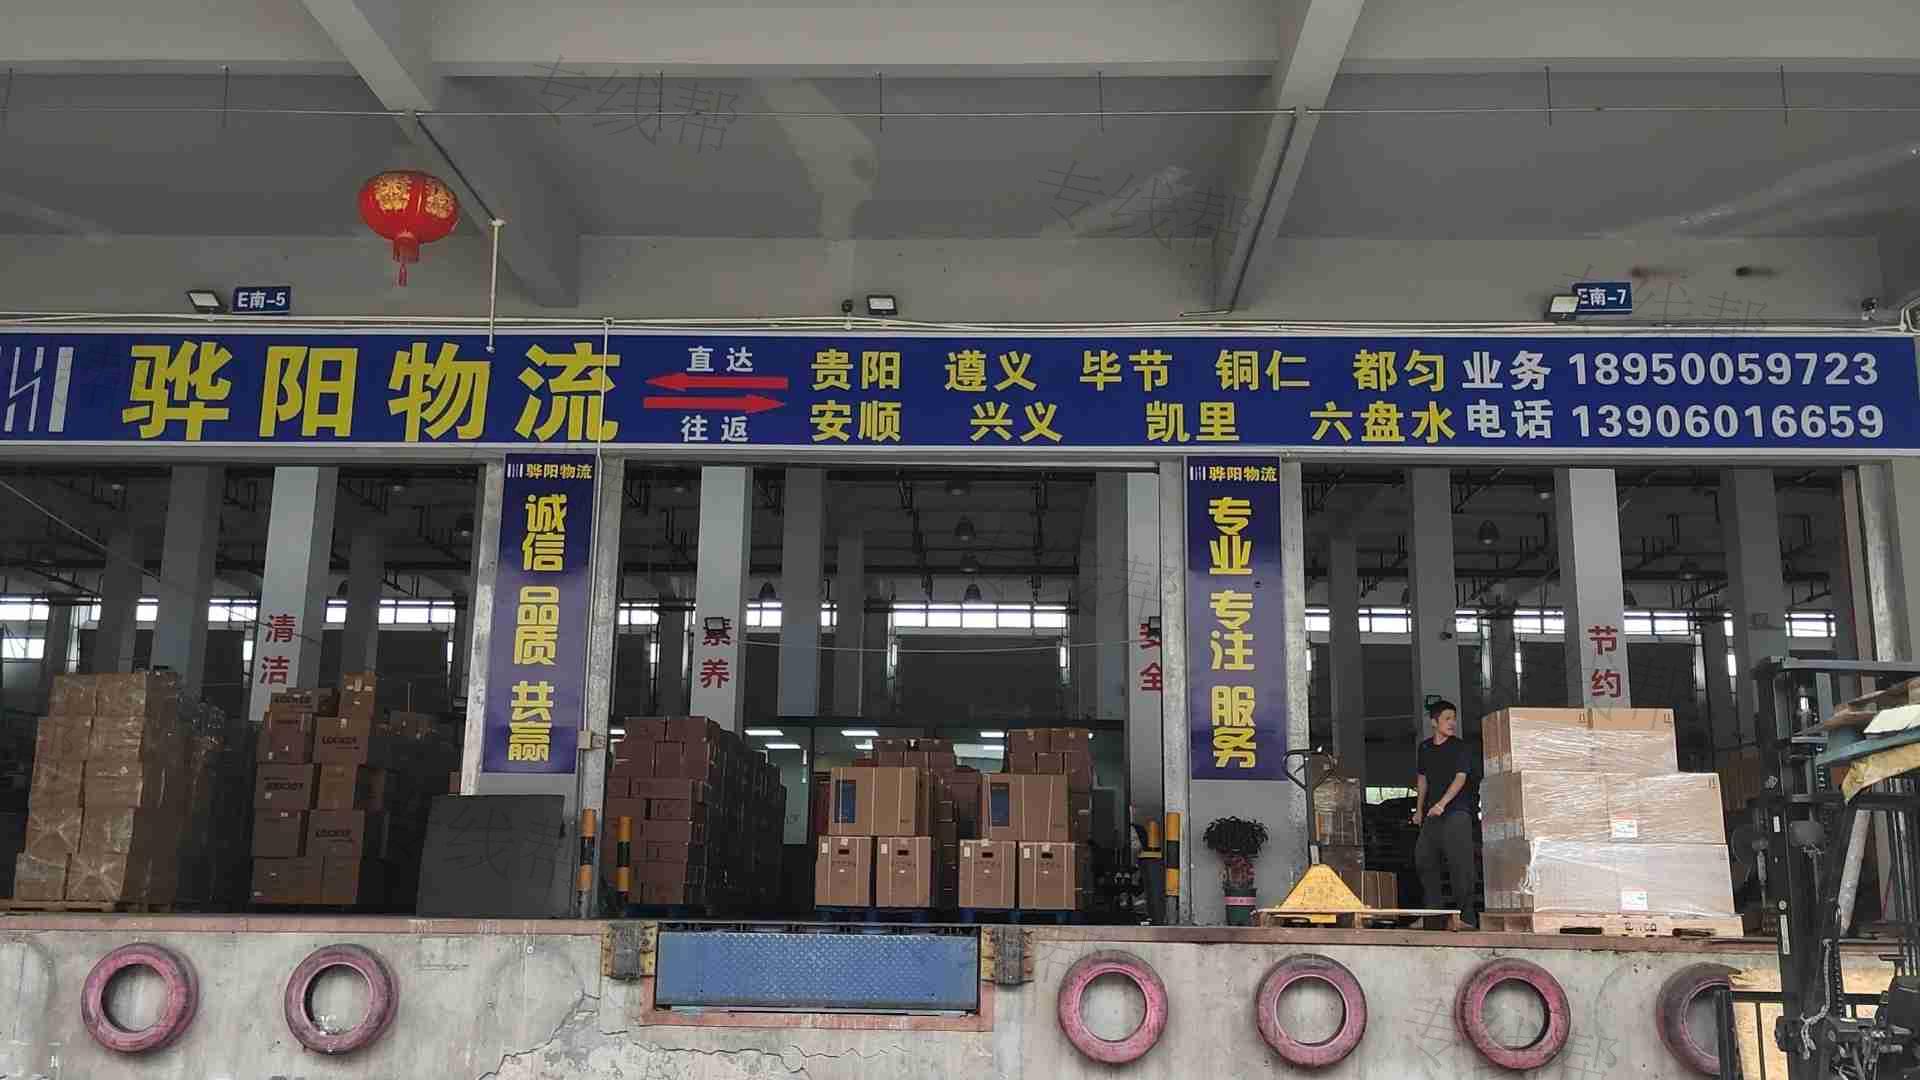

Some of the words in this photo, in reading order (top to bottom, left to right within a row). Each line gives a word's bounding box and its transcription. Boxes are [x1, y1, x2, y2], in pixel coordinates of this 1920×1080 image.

[237, 289, 286, 309] E南-5
[686, 345, 754, 373] 直达
[810, 348, 902, 391] 贵阳
[944, 350, 1037, 392] 遵义
[1079, 349, 1173, 391] 毕节
[1215, 349, 1311, 391] 铜仁
[1353, 349, 1445, 392] 都匀
[1462, 351, 1551, 391] 业务
[1568, 352, 1878, 386] 18950059723
[122, 340, 622, 442] 骅阳物流
[1466, 400, 1554, 439] 电话
[1572, 405, 1884, 438] 13906016659
[681, 415, 749, 442] 往返
[810, 400, 902, 442] 安顺
[969, 401, 1064, 442] 兴义
[1145, 401, 1241, 442] 凯里
[1310, 400, 1457, 443] 六盘水
[526, 463, 593, 479] 骅阳物流
[1208, 466, 1278, 482] 骅阳物流
[521, 494, 568, 572] 诚信
[1208, 496, 1253, 576] 专业
[259, 614, 297, 685] 清洁
[512, 585, 560, 666] 品质
[1209, 590, 1255, 671] 专注
[1588, 625, 1622, 698] 节约
[507, 680, 554, 761] 共赢
[1210, 685, 1257, 769] 服务
